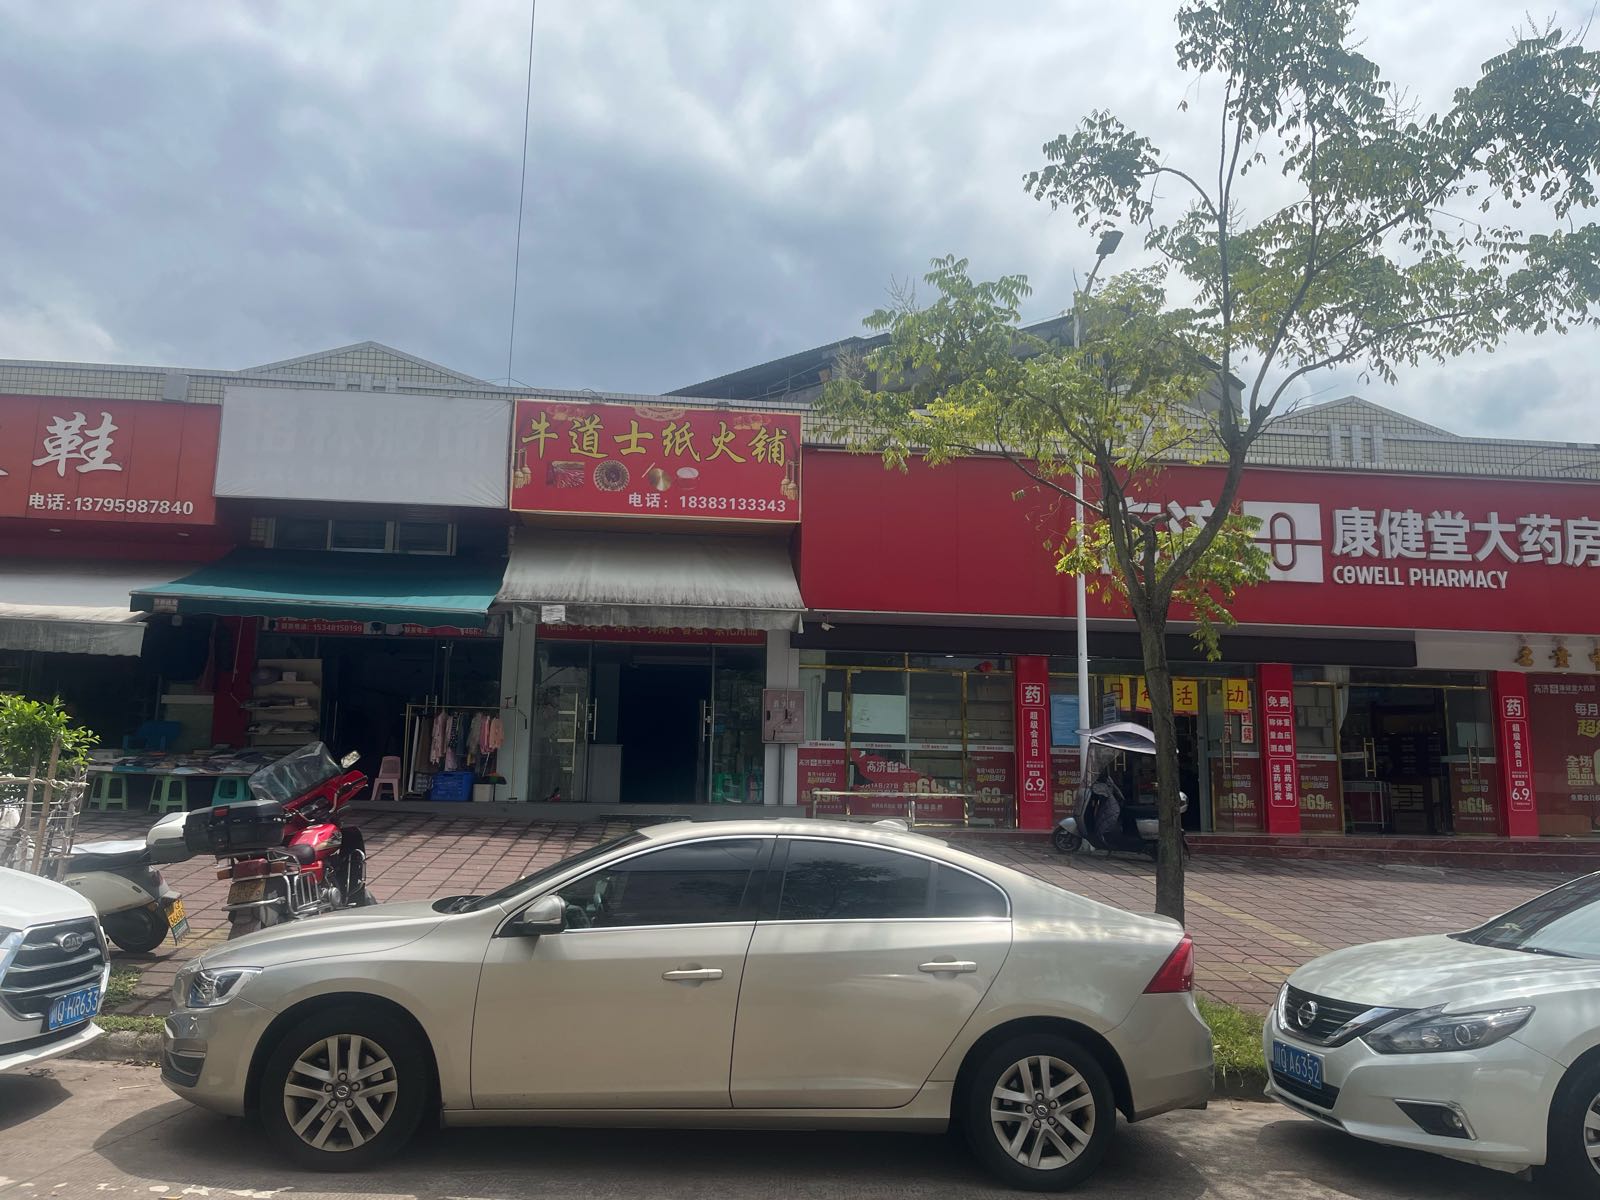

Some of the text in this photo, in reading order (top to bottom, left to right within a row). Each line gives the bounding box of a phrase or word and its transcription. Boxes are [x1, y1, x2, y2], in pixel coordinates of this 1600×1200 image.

[679, 495, 787, 512] 18383133343
[1331, 506, 1600, 568] 康健堂大药房
[1408, 569, 1508, 590] PHARMACY
[1024, 685, 1041, 703] 药
[1268, 696, 1289, 707] 免费
[1506, 698, 1522, 716] 药
[1574, 702, 1598, 716] 每月
[1029, 711, 1039, 757] 超级会员日
[867, 761, 886, 773] 高济
[1566, 755, 1592, 767] 全场
[1567, 767, 1593, 780] 商品
[1025, 778, 1045, 791] 6.9
[1512, 788, 1530, 801] 6.9
